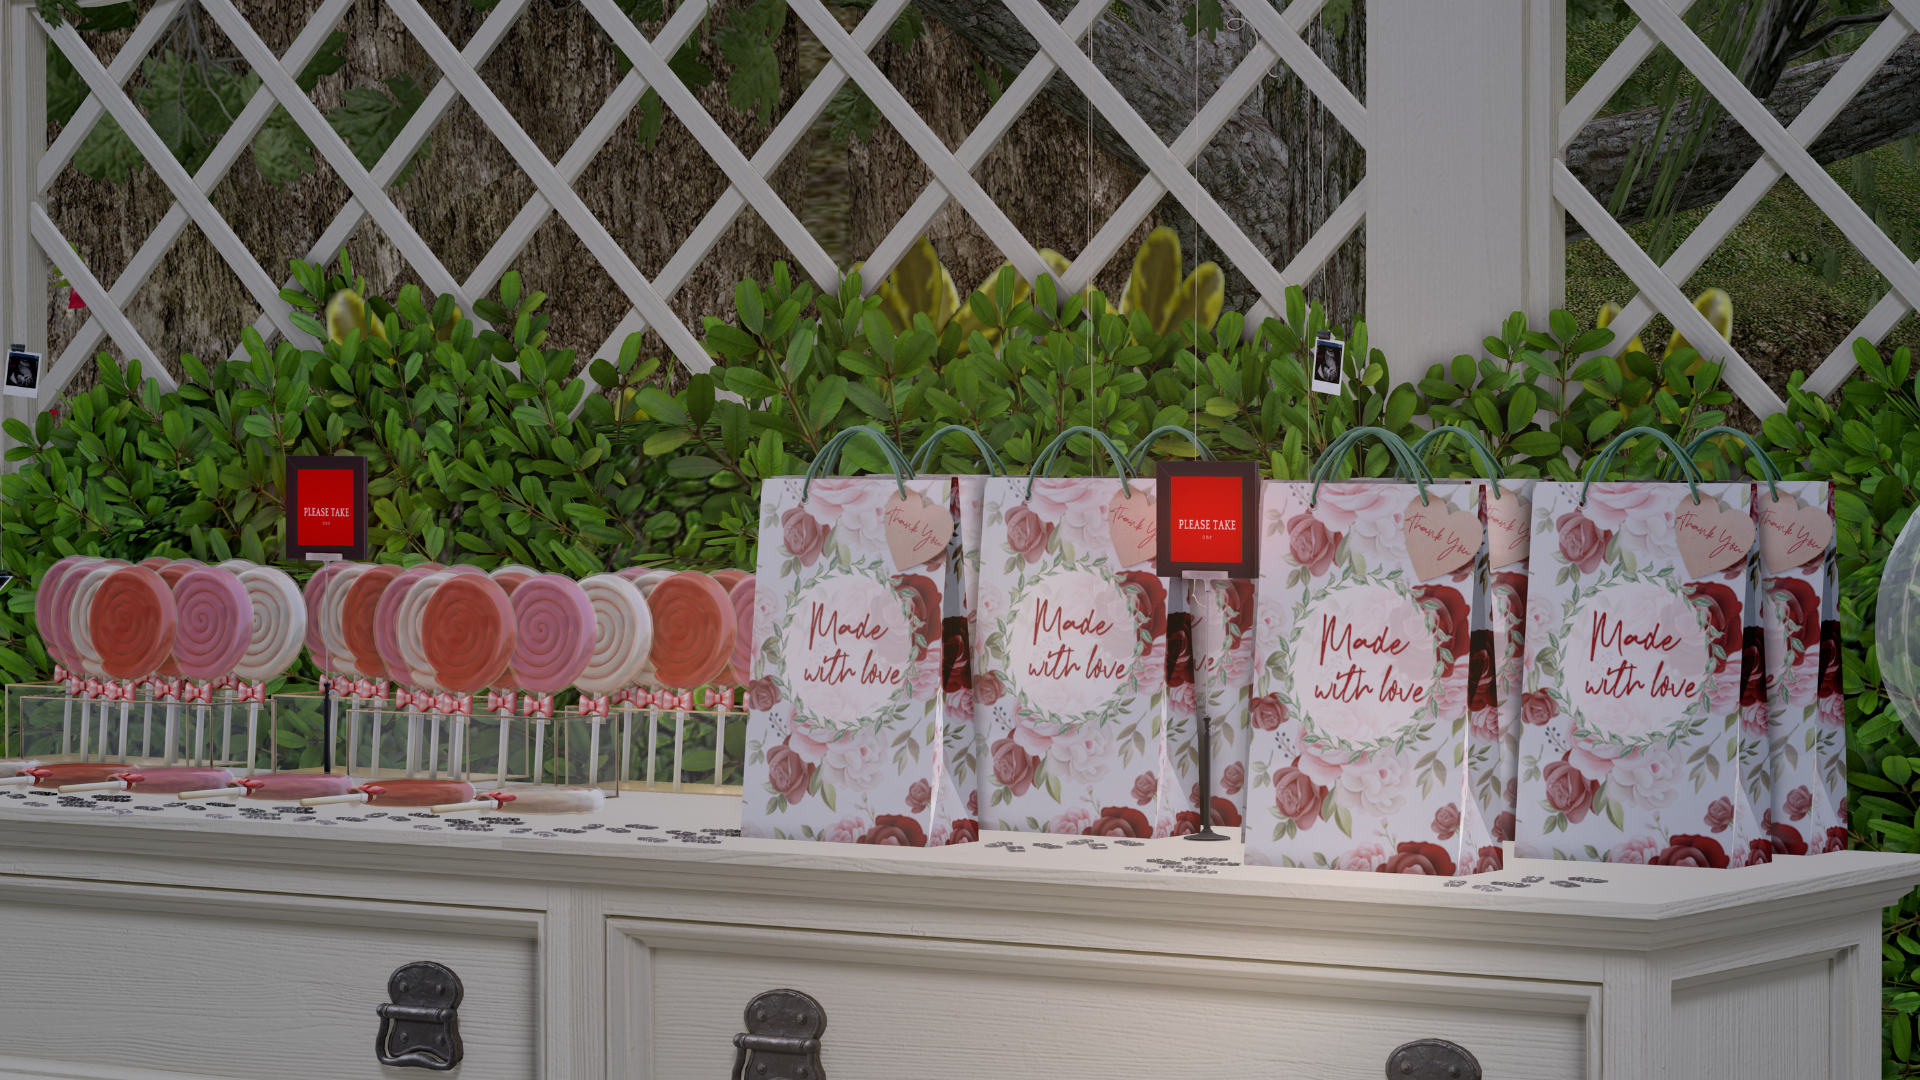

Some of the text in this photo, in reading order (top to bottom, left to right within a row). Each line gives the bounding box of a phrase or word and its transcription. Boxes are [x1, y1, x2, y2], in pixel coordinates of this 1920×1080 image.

[303, 507, 350, 517] PLEASE TAKE
[886, 506, 943, 552] Thank You
[1110, 504, 1146, 531] Thank
[1178, 518, 1237, 530] PLEASE TAKE
[1405, 512, 1472, 561] Thank You
[1676, 510, 1744, 558] Thank You
[1787, 526, 1822, 554] You
[809, 601, 889, 651] Made
[1033, 597, 1114, 646] Made
[1320, 613, 1410, 666] Made
[1590, 610, 1682, 662] Made
[804, 648, 901, 686] with love
[1028, 643, 1126, 680] with love
[1585, 659, 1697, 698] with love
[1314, 664, 1425, 703] with love
